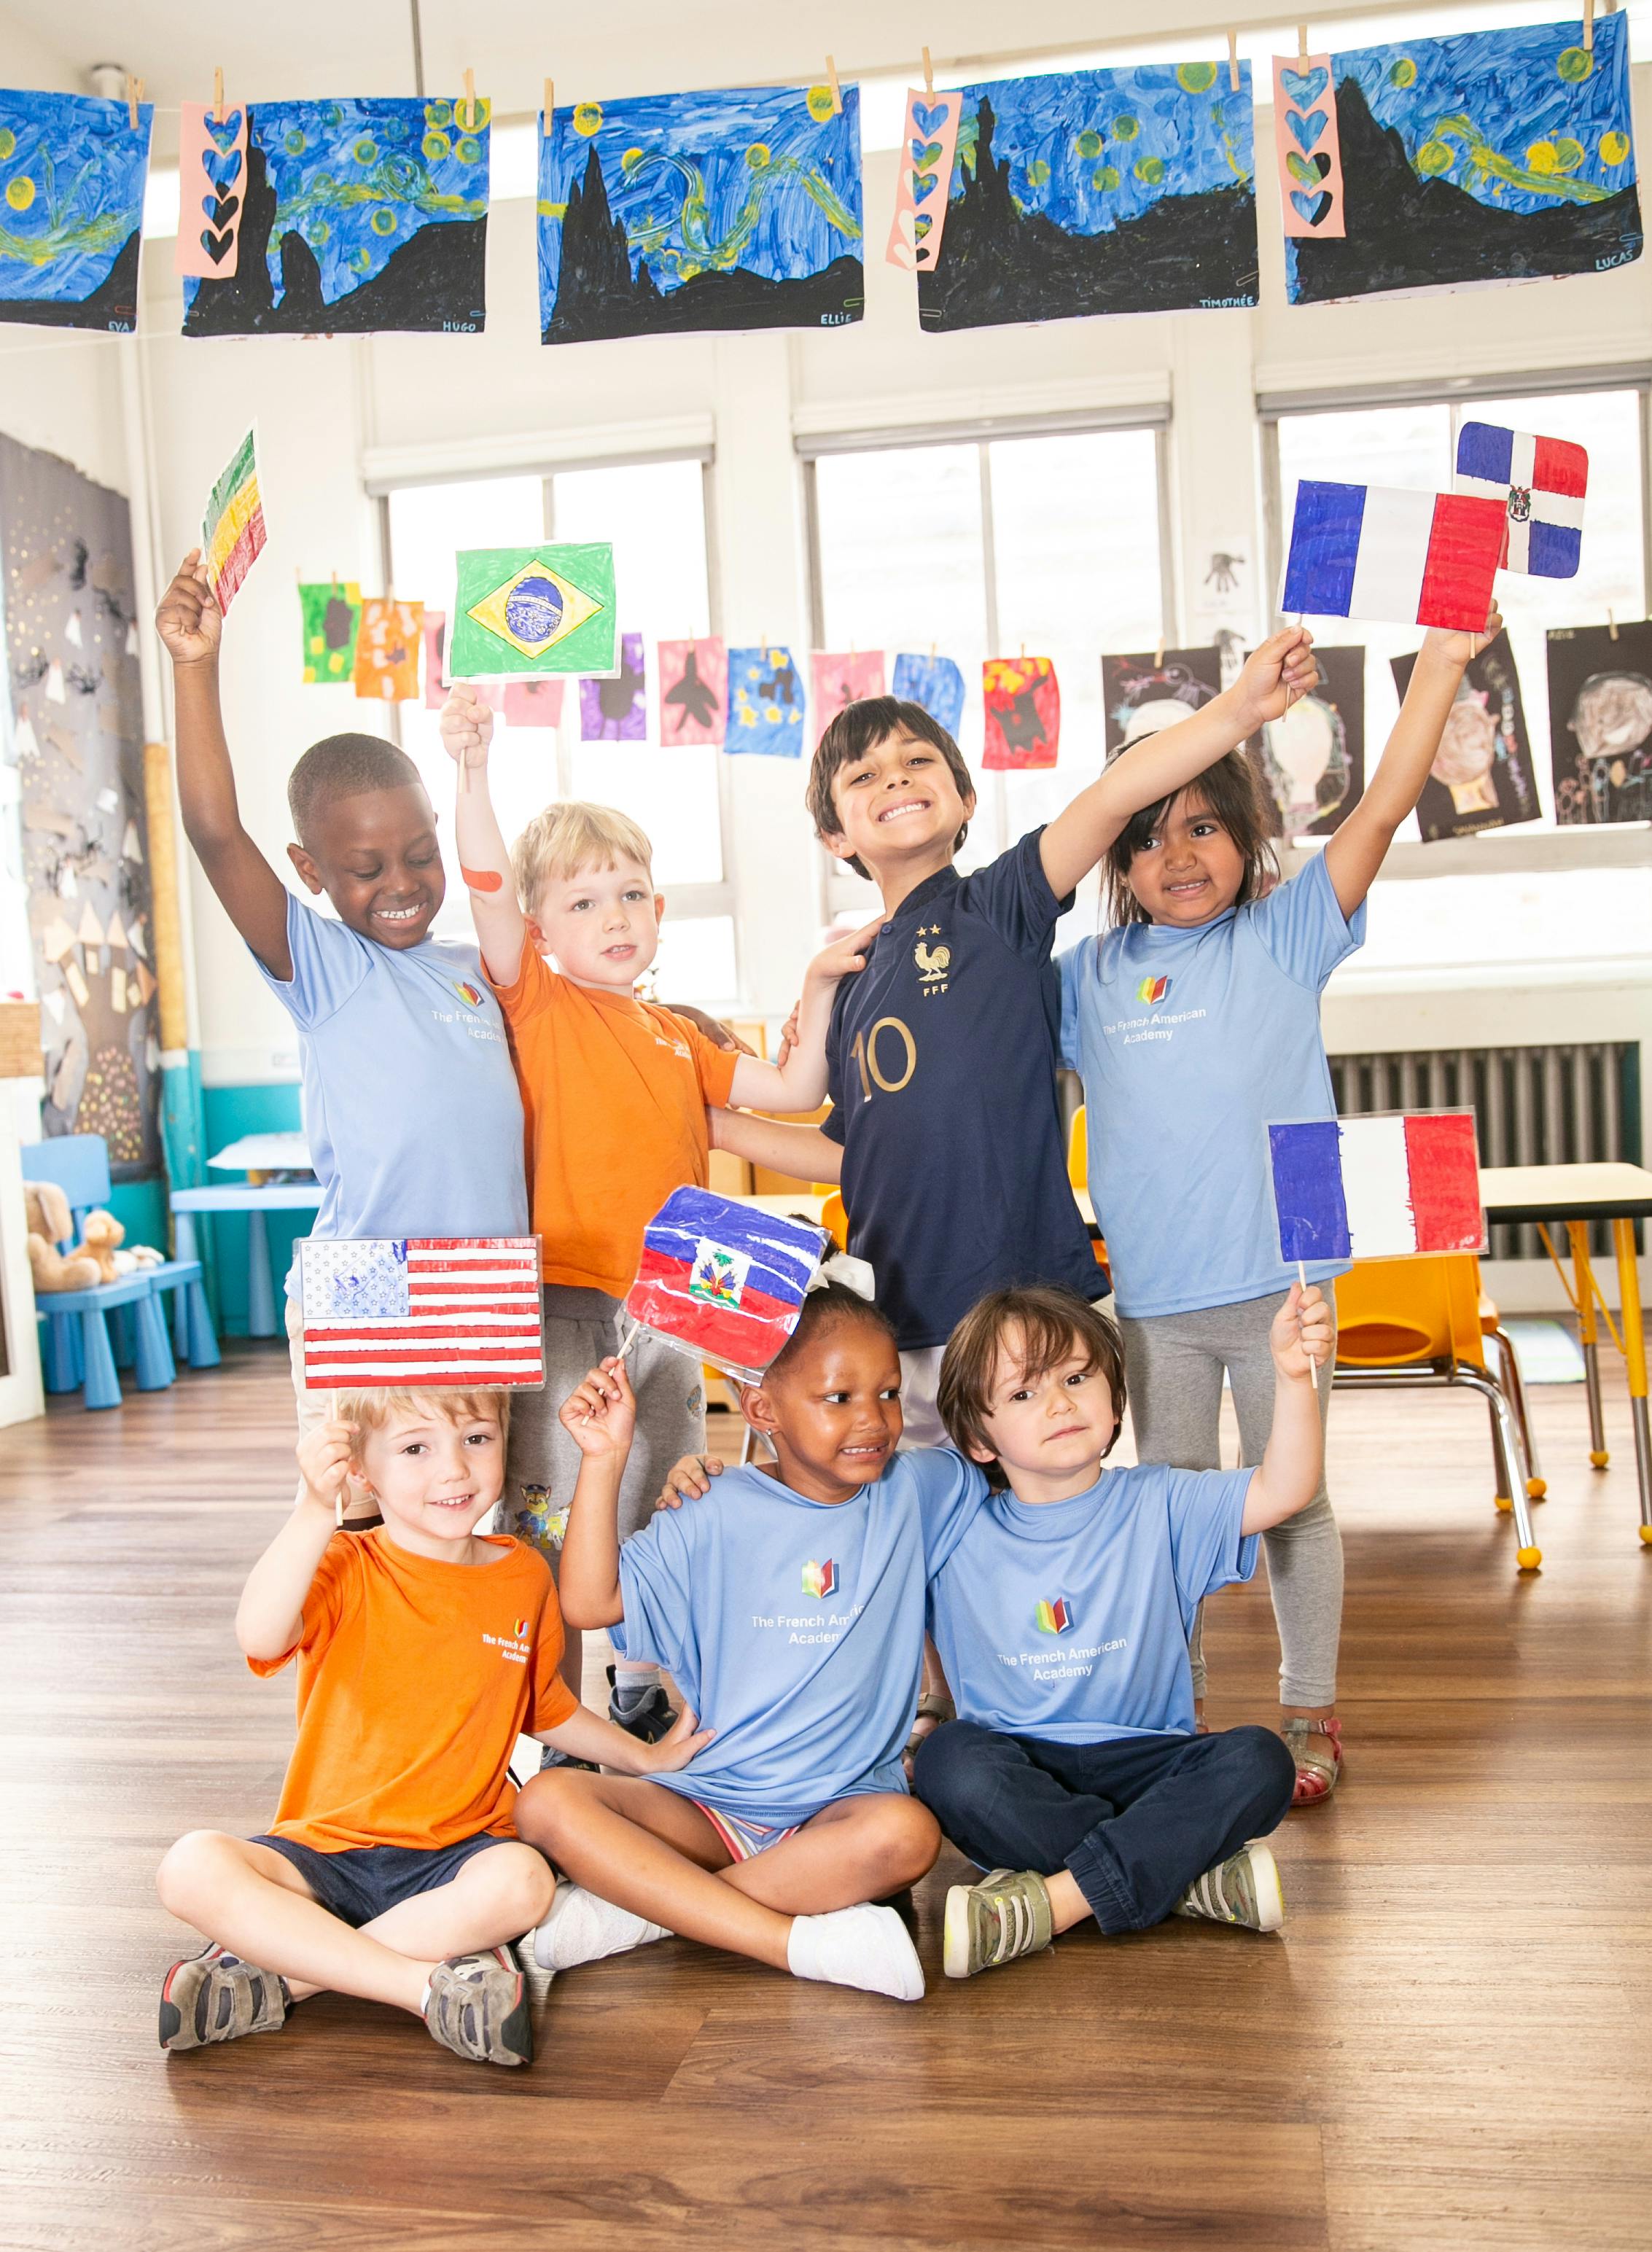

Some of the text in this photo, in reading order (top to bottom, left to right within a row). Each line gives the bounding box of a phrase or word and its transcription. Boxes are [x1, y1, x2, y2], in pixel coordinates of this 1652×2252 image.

[1595, 249, 1634, 270] LUCAS
[109, 321, 130, 333] EVA
[443, 321, 476, 332] HUGO
[923, 984, 948, 997] FFF
[432, 1010, 453, 1023] The
[1102, 1008, 1207, 1035] The French American
[1123, 1029, 1174, 1045] Academy
[850, 1016, 916, 1102] 10
[752, 1616, 774, 1628] The
[777, 1615, 825, 1628] French
[482, 1633, 496, 1645] The
[498, 1637, 518, 1650] French
[502, 1649, 528, 1664] Academ
[997, 1638, 1128, 1667] The French American
[1033, 1664, 1093, 1681] Academy
